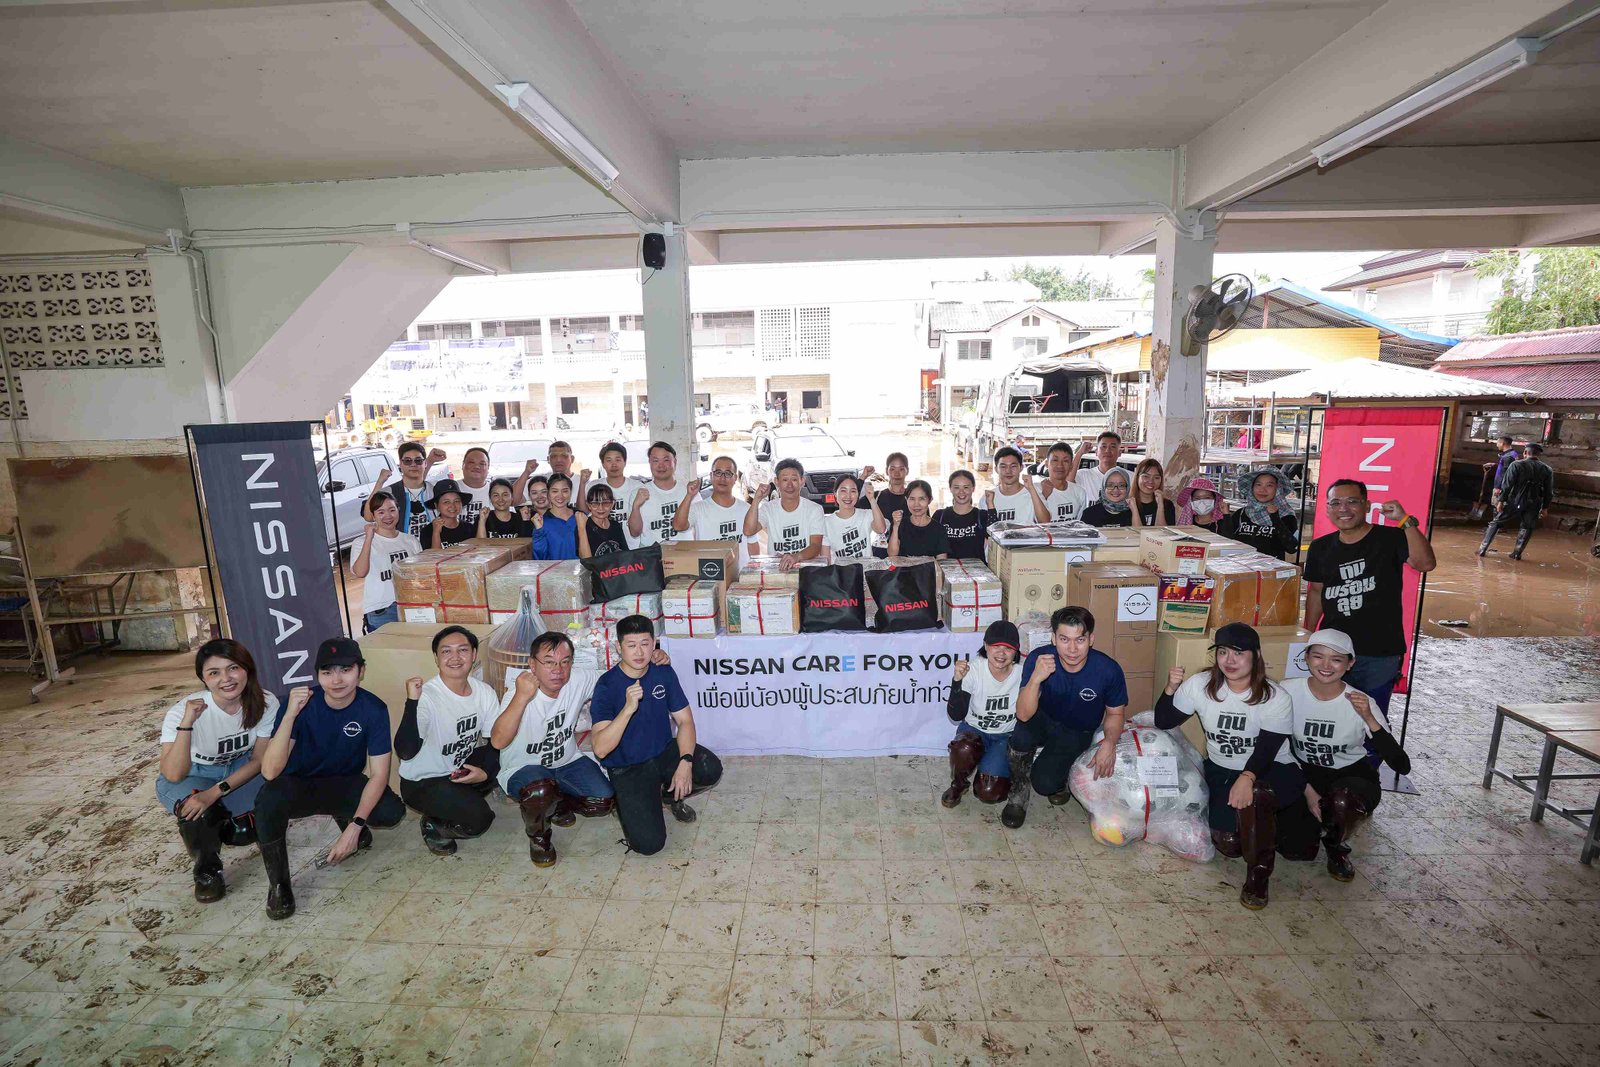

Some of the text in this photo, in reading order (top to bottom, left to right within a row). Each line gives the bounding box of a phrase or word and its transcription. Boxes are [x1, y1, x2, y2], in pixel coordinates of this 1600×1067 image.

[241, 453, 314, 685] NISSAN
[599, 563, 645, 579] NISSAN
[810, 598, 858, 608] NISSAN
[884, 599, 929, 613] NISSAN
[694, 657, 785, 675] NISSAN
[791, 654, 856, 672] CARE
[863, 654, 914, 672] FOR
[697, 677, 952, 711] เพื่อพี่น้องผู้ประสบภัยน้ำท่ว
